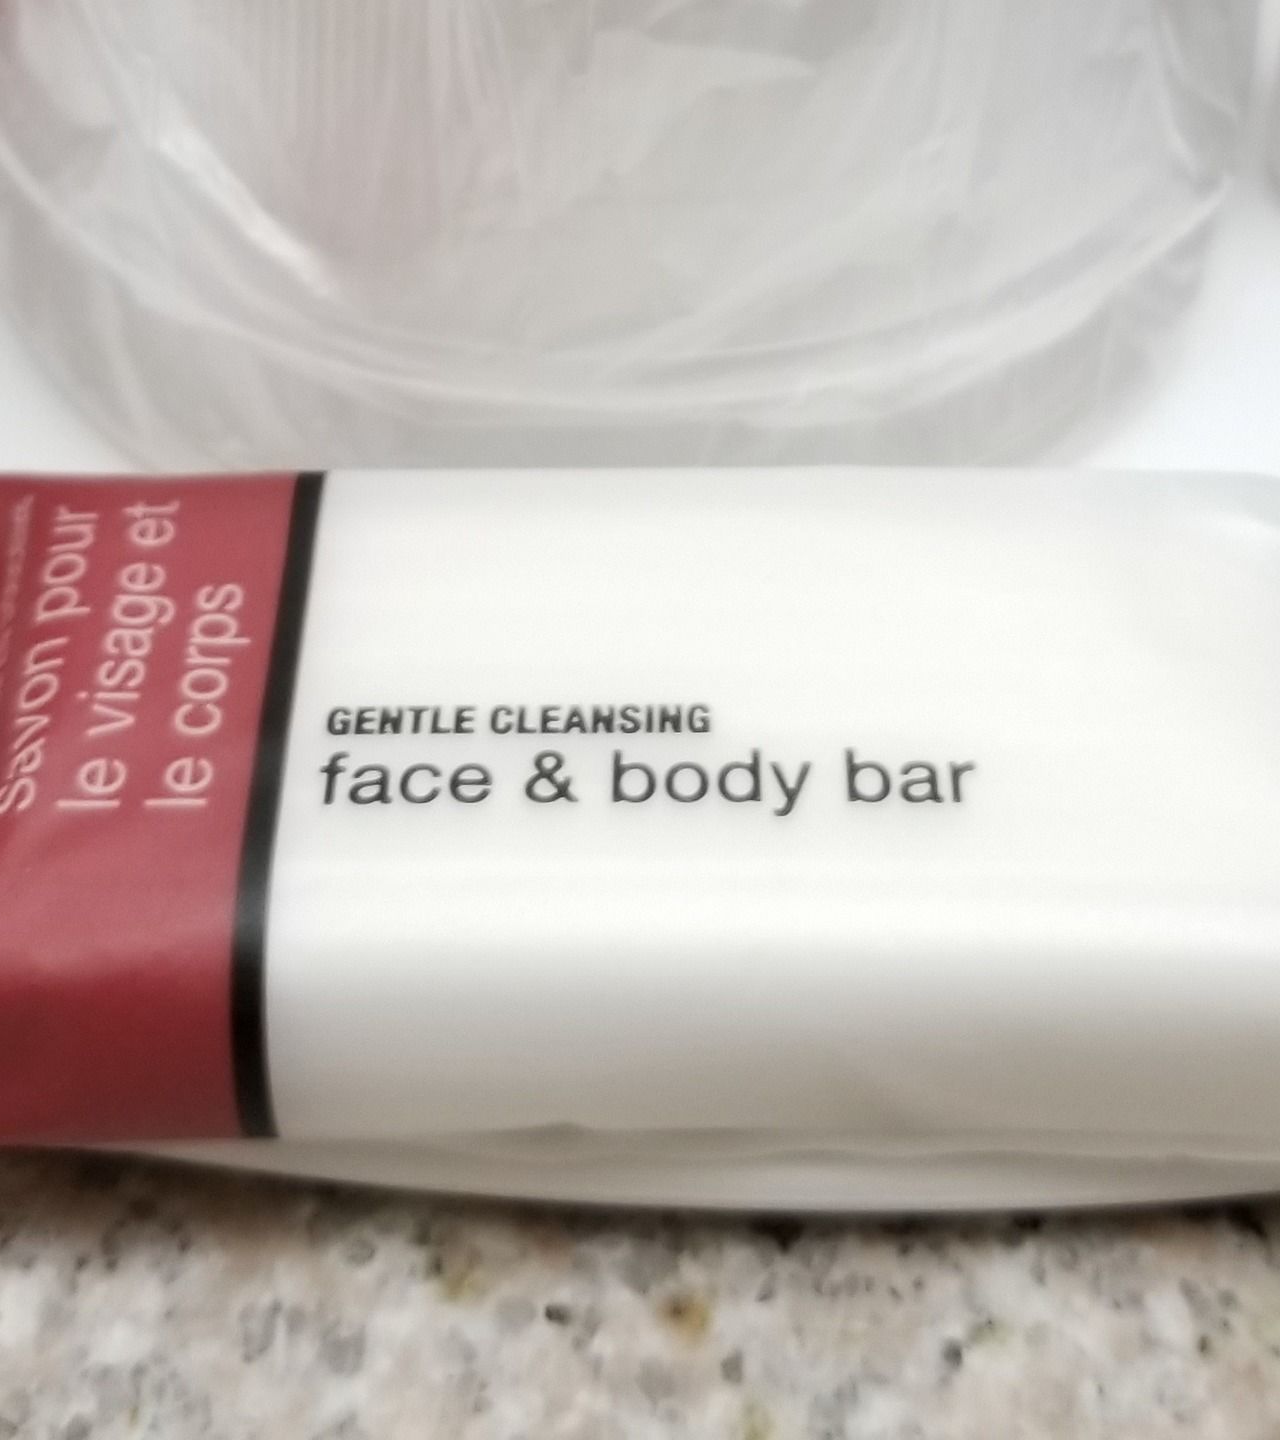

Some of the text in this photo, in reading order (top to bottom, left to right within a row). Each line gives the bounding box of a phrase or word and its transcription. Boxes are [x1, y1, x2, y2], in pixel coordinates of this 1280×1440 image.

[36, 504, 99, 623] pour
[55, 499, 180, 809] le visage et
[143, 582, 251, 808] le corps
[326, 704, 711, 735] GENTLE CLEANSING
[320, 747, 976, 817] face & body bar
